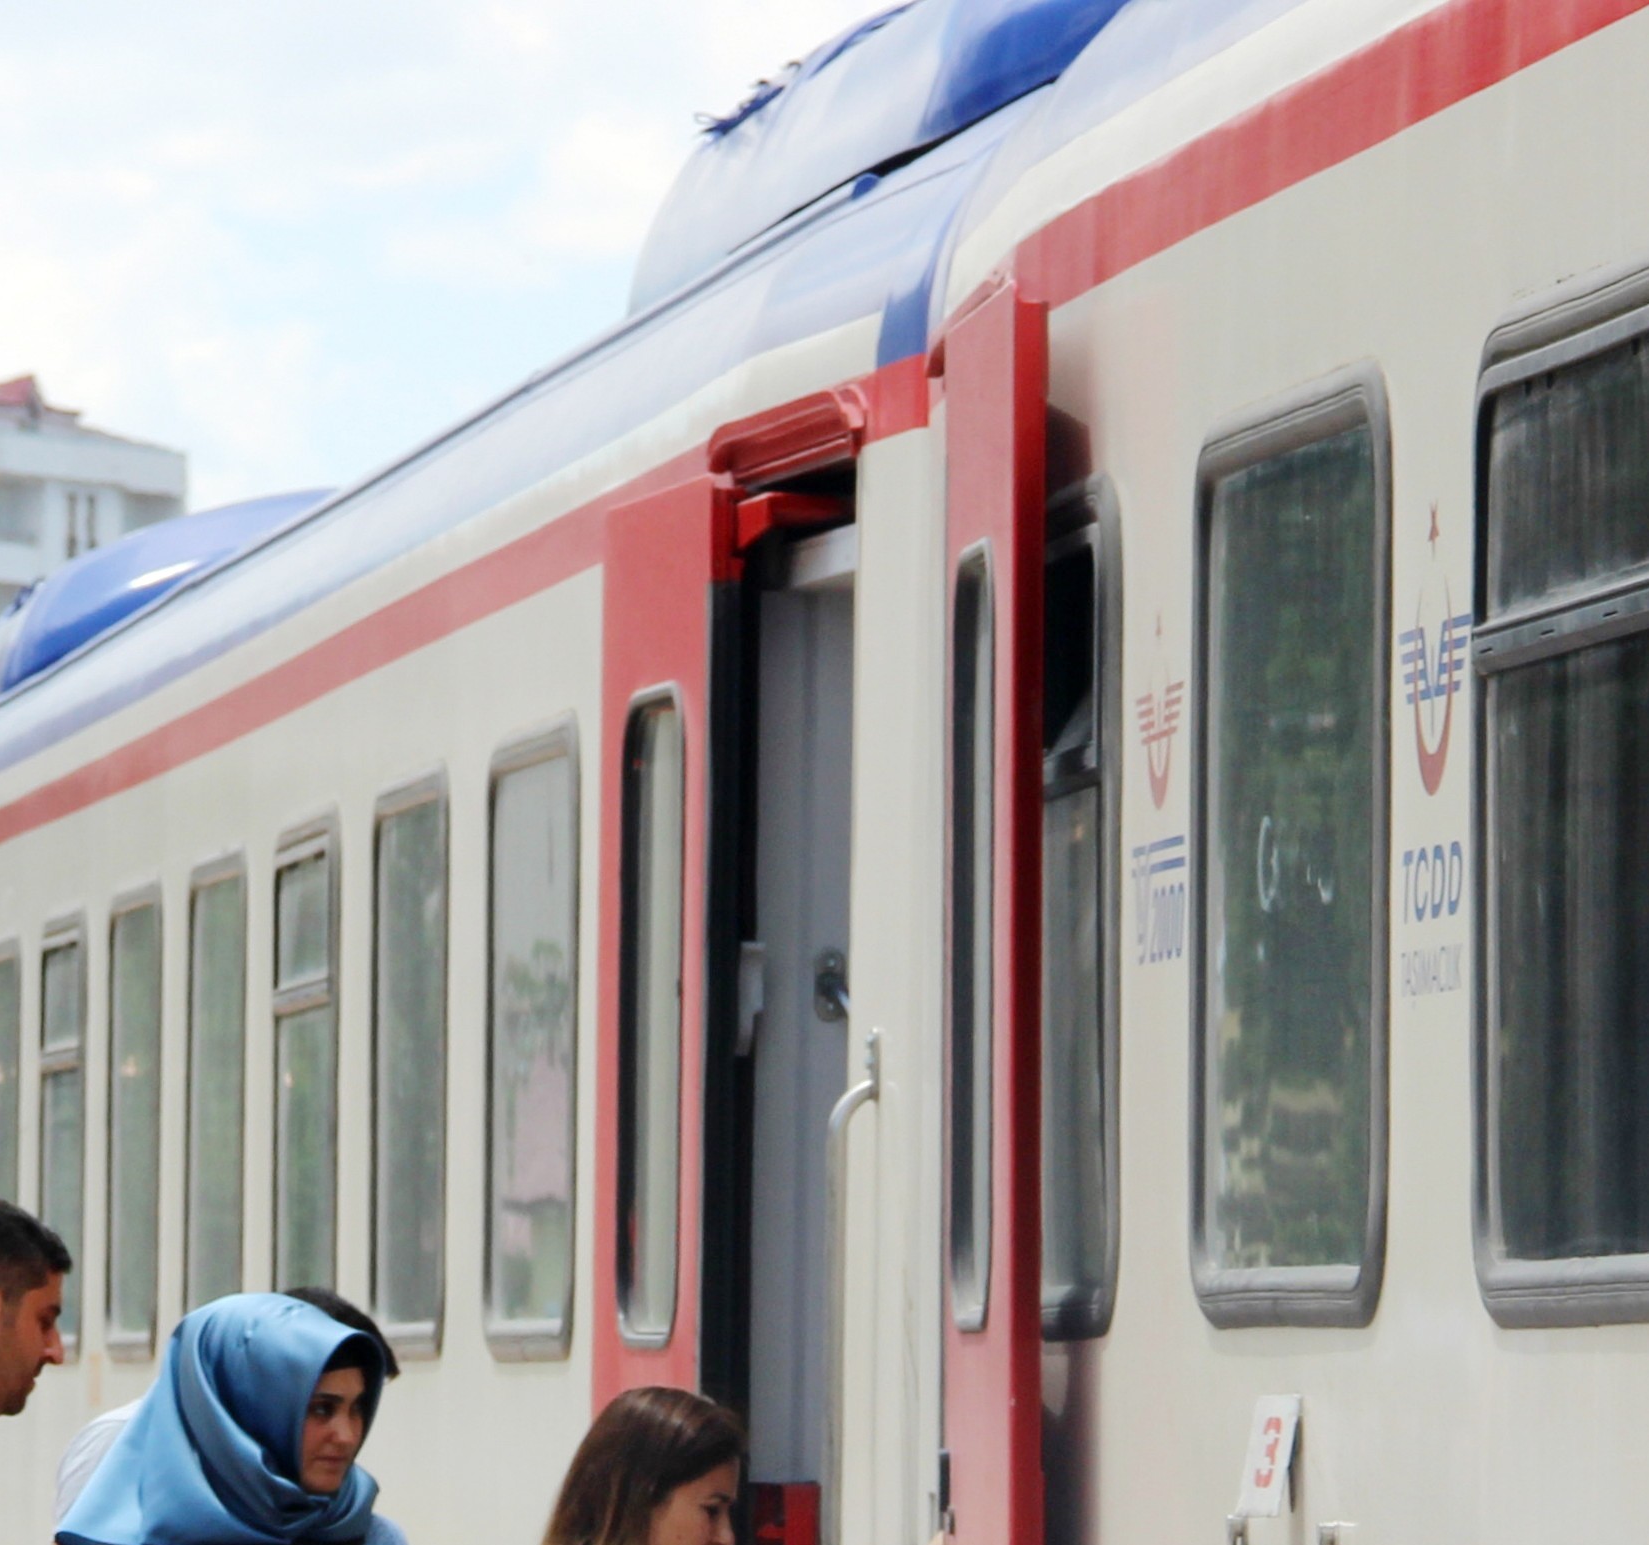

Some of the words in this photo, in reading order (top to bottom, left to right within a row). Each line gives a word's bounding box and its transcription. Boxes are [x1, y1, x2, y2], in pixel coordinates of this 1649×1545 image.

[1150, 882, 1185, 963] 2000
[1401, 841, 1463, 924] TCDD
[1253, 1416, 1283, 1489] 3
